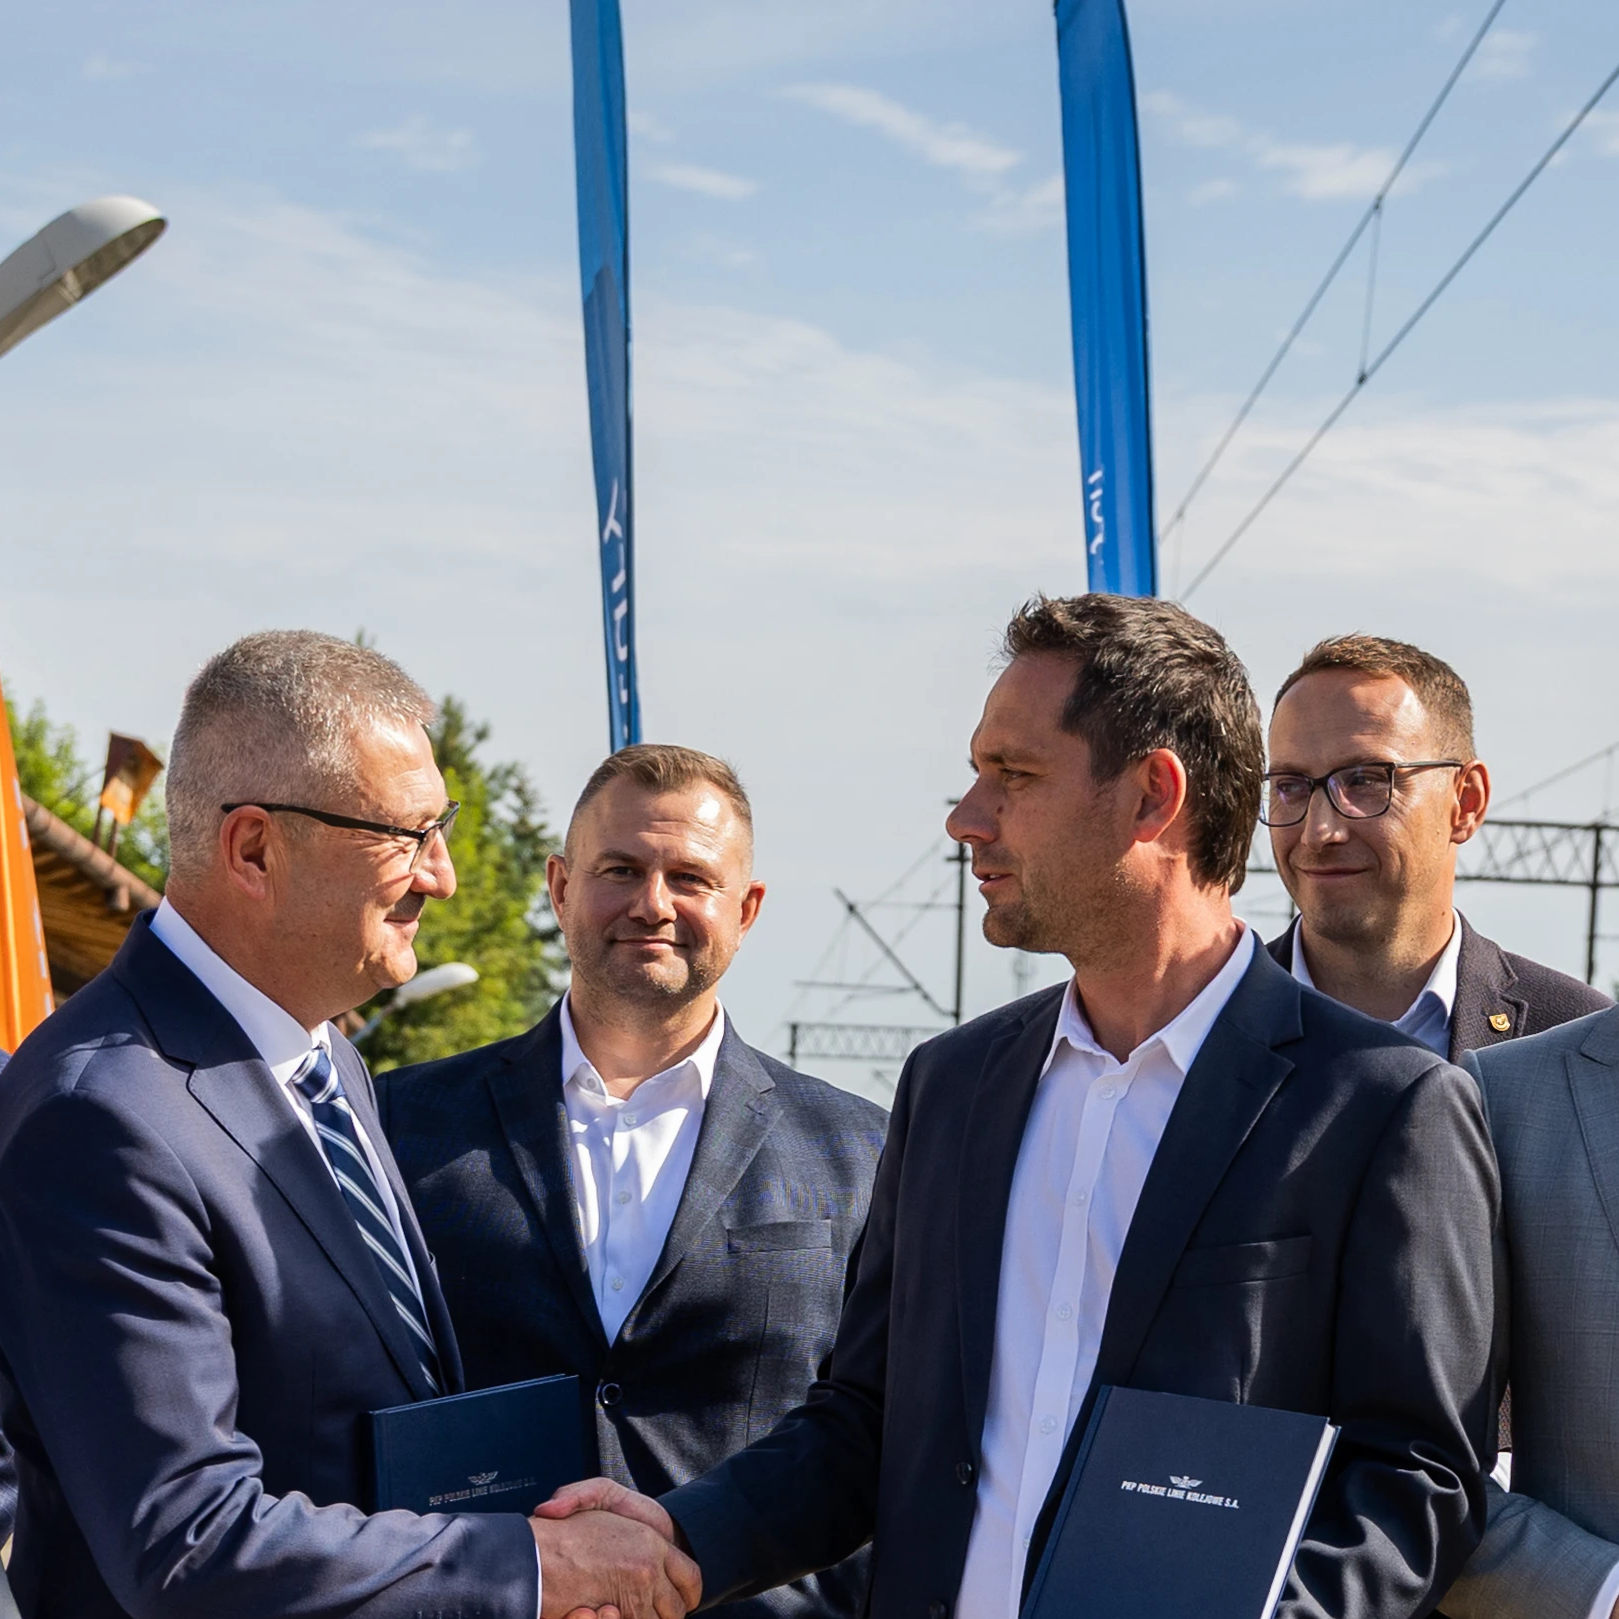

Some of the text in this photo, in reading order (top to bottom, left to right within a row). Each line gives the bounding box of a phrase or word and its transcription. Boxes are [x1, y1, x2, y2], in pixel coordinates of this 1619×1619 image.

[1121, 1480, 1240, 1509] PKP POLSKIE LINIE KOLEJOWE S.A.
